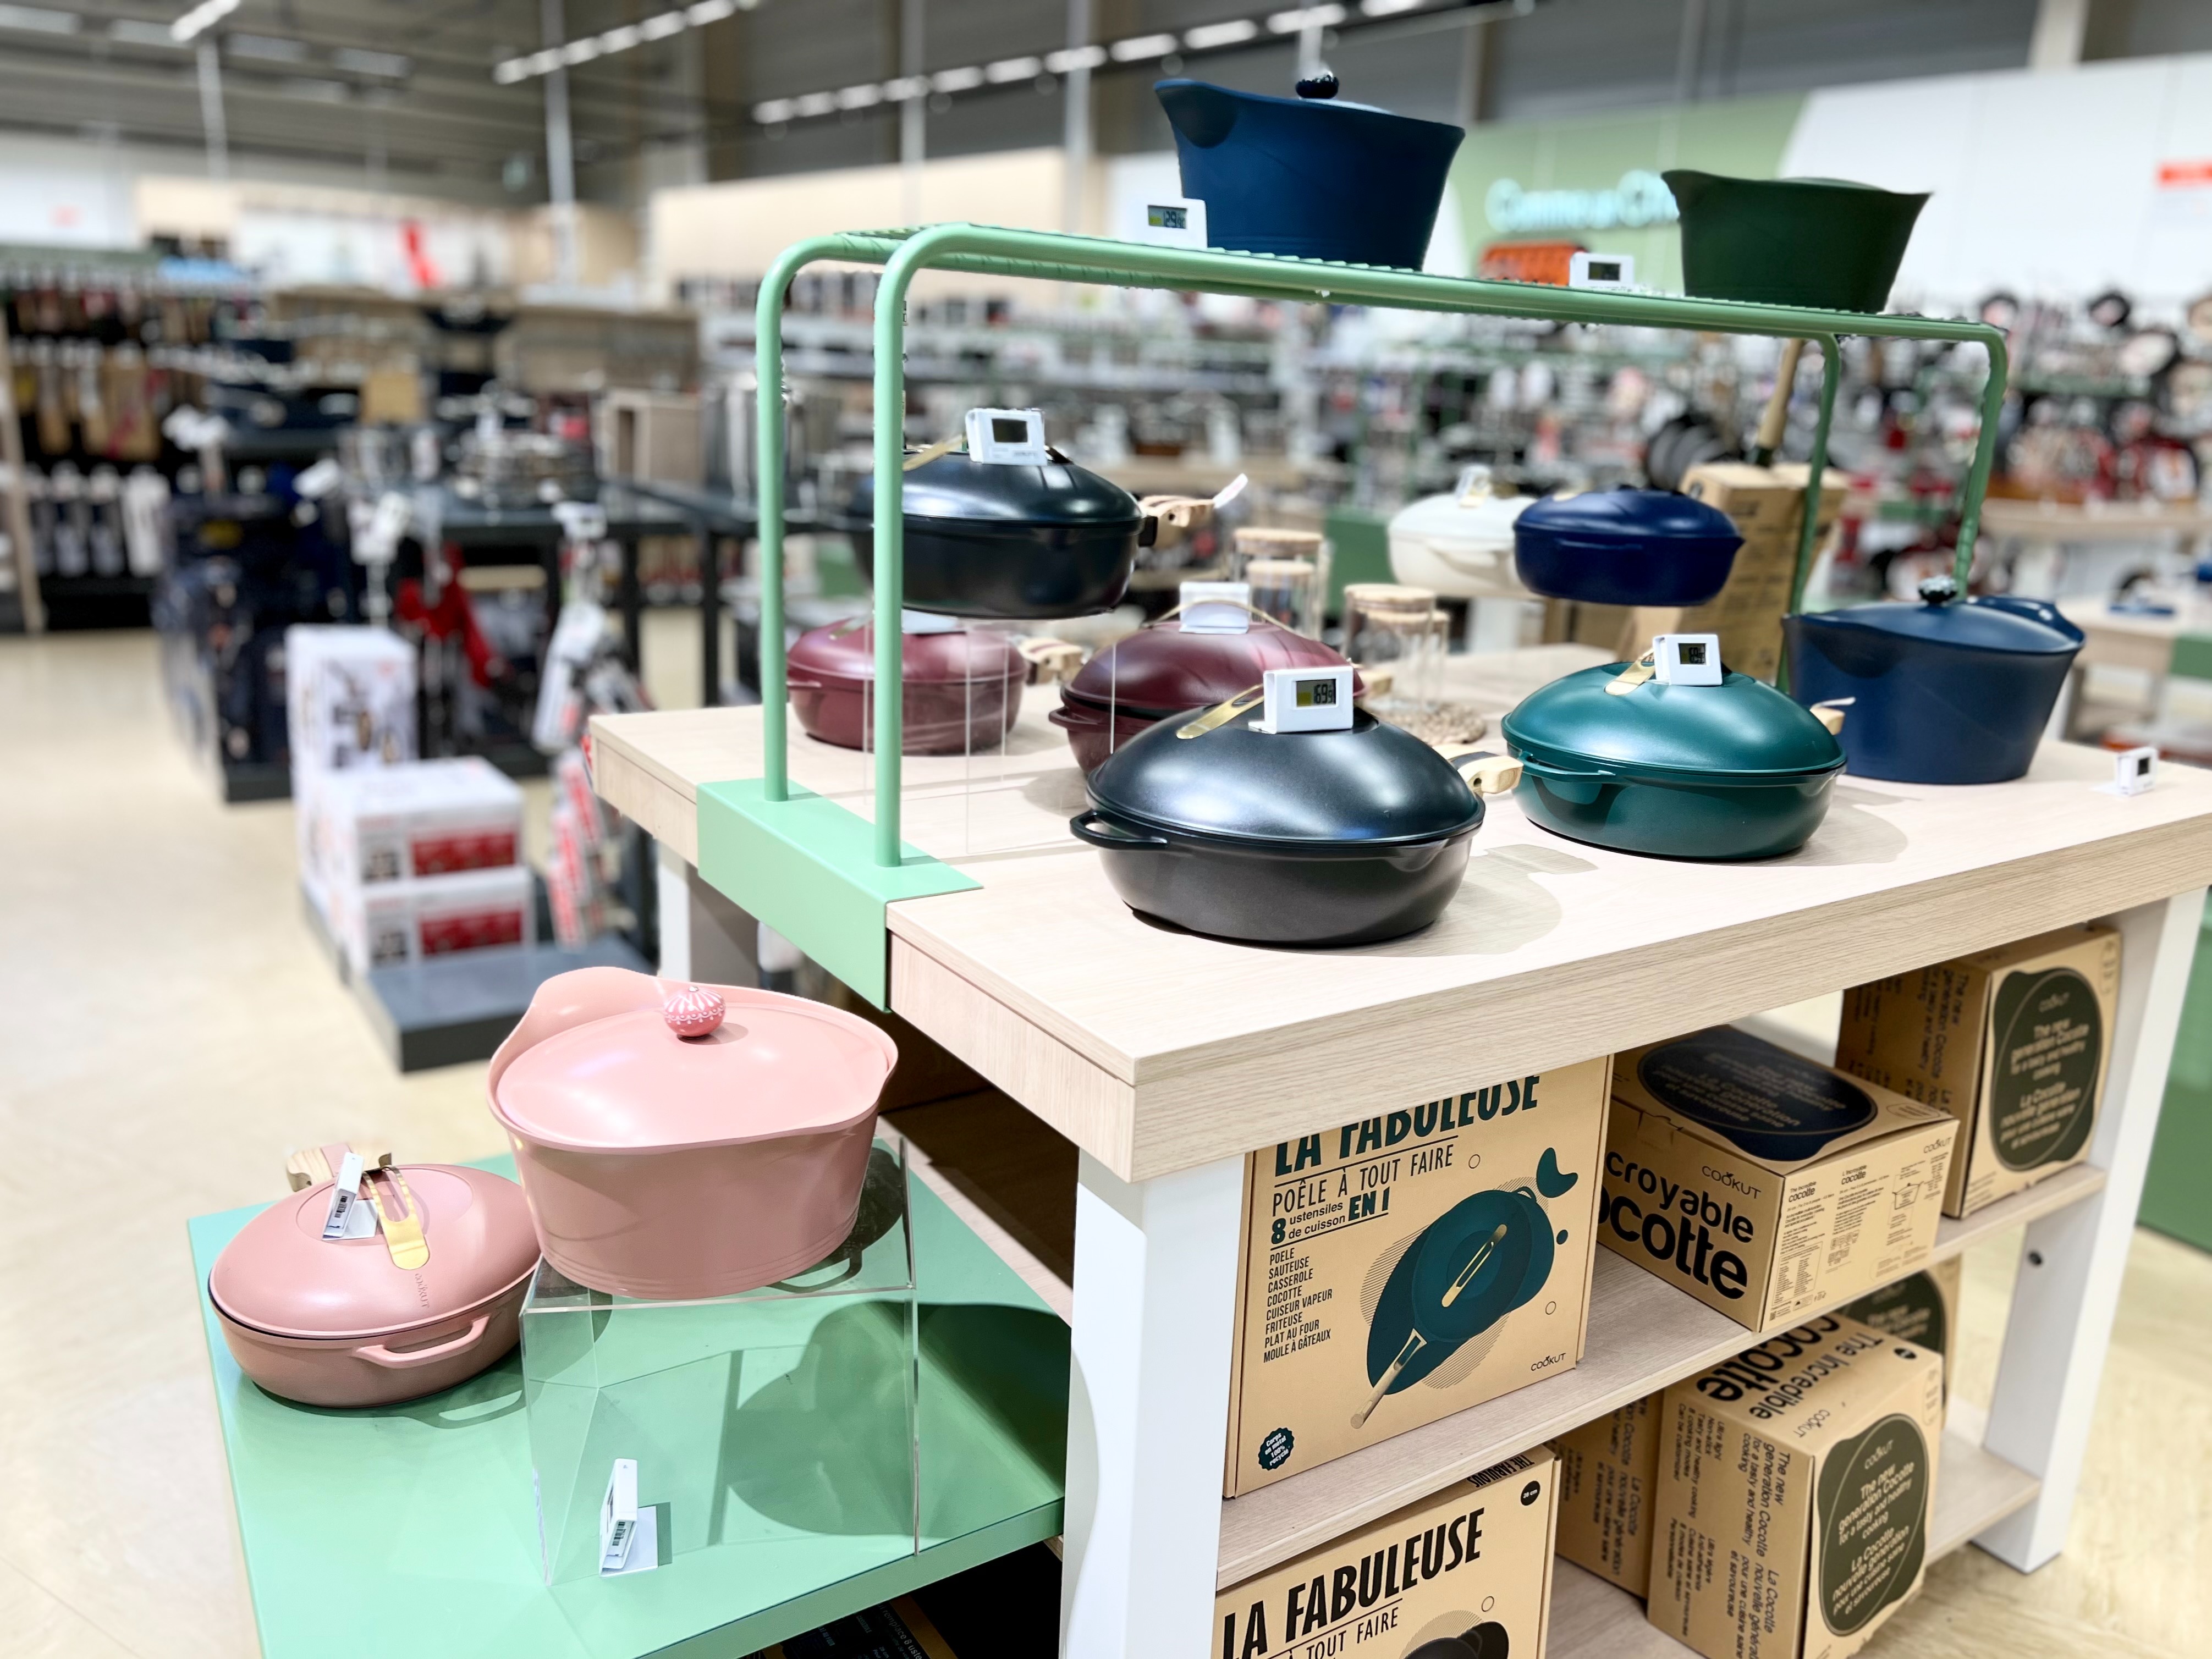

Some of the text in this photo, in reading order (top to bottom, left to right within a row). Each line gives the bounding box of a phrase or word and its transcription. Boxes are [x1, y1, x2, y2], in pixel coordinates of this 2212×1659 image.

[1275, 1076, 1540, 1176] LA FABULEUSE
[1273, 1179, 1327, 1216] POÊLE
[1360, 1159, 1400, 1190] TOUT
[1411, 1145, 1454, 1176] FAIRE
[1702, 1166, 1761, 1199] COOKUT
[1841, 1171, 1866, 1184] cocotte
[1349, 1190, 1377, 1221] EN
[1789, 1188, 1815, 1202] cocotte
[1289, 1215, 1345, 1239] de cuisson
[1290, 1203, 1343, 1225] ustensiles
[1271, 1218, 1286, 1244] 8
[1269, 1256, 1309, 1279] SAUTEUSE
[1270, 1248, 1295, 1265] POELE
[1267, 1286, 1302, 1307] COCOTTE
[1268, 1269, 1313, 1293] CASSEROLE
[1267, 1289, 1333, 1321] CUISEUR VAPEUR
[1265, 1320, 1319, 1348] PLAT AU FOUR
[1266, 1312, 1302, 1335] FRITEUSE
[1264, 1329, 1331, 1363] MOULE À GÂTEAUX
[1749, 1332, 1884, 1420] The Incredible
[1267, 1433, 1281, 1447] Corps
[1467, 1455, 1535, 1487] THE FABULOUS
[1775, 1453, 1790, 1506] The new
[1861, 1464, 1896, 1499] The new
[1756, 1443, 1775, 1557] generation Cocotte
[1223, 1508, 1484, 1659] LA FABULEUSE
[1764, 1569, 1779, 1634] La Cocotte
[1357, 1607, 1399, 1644] FAIRE
